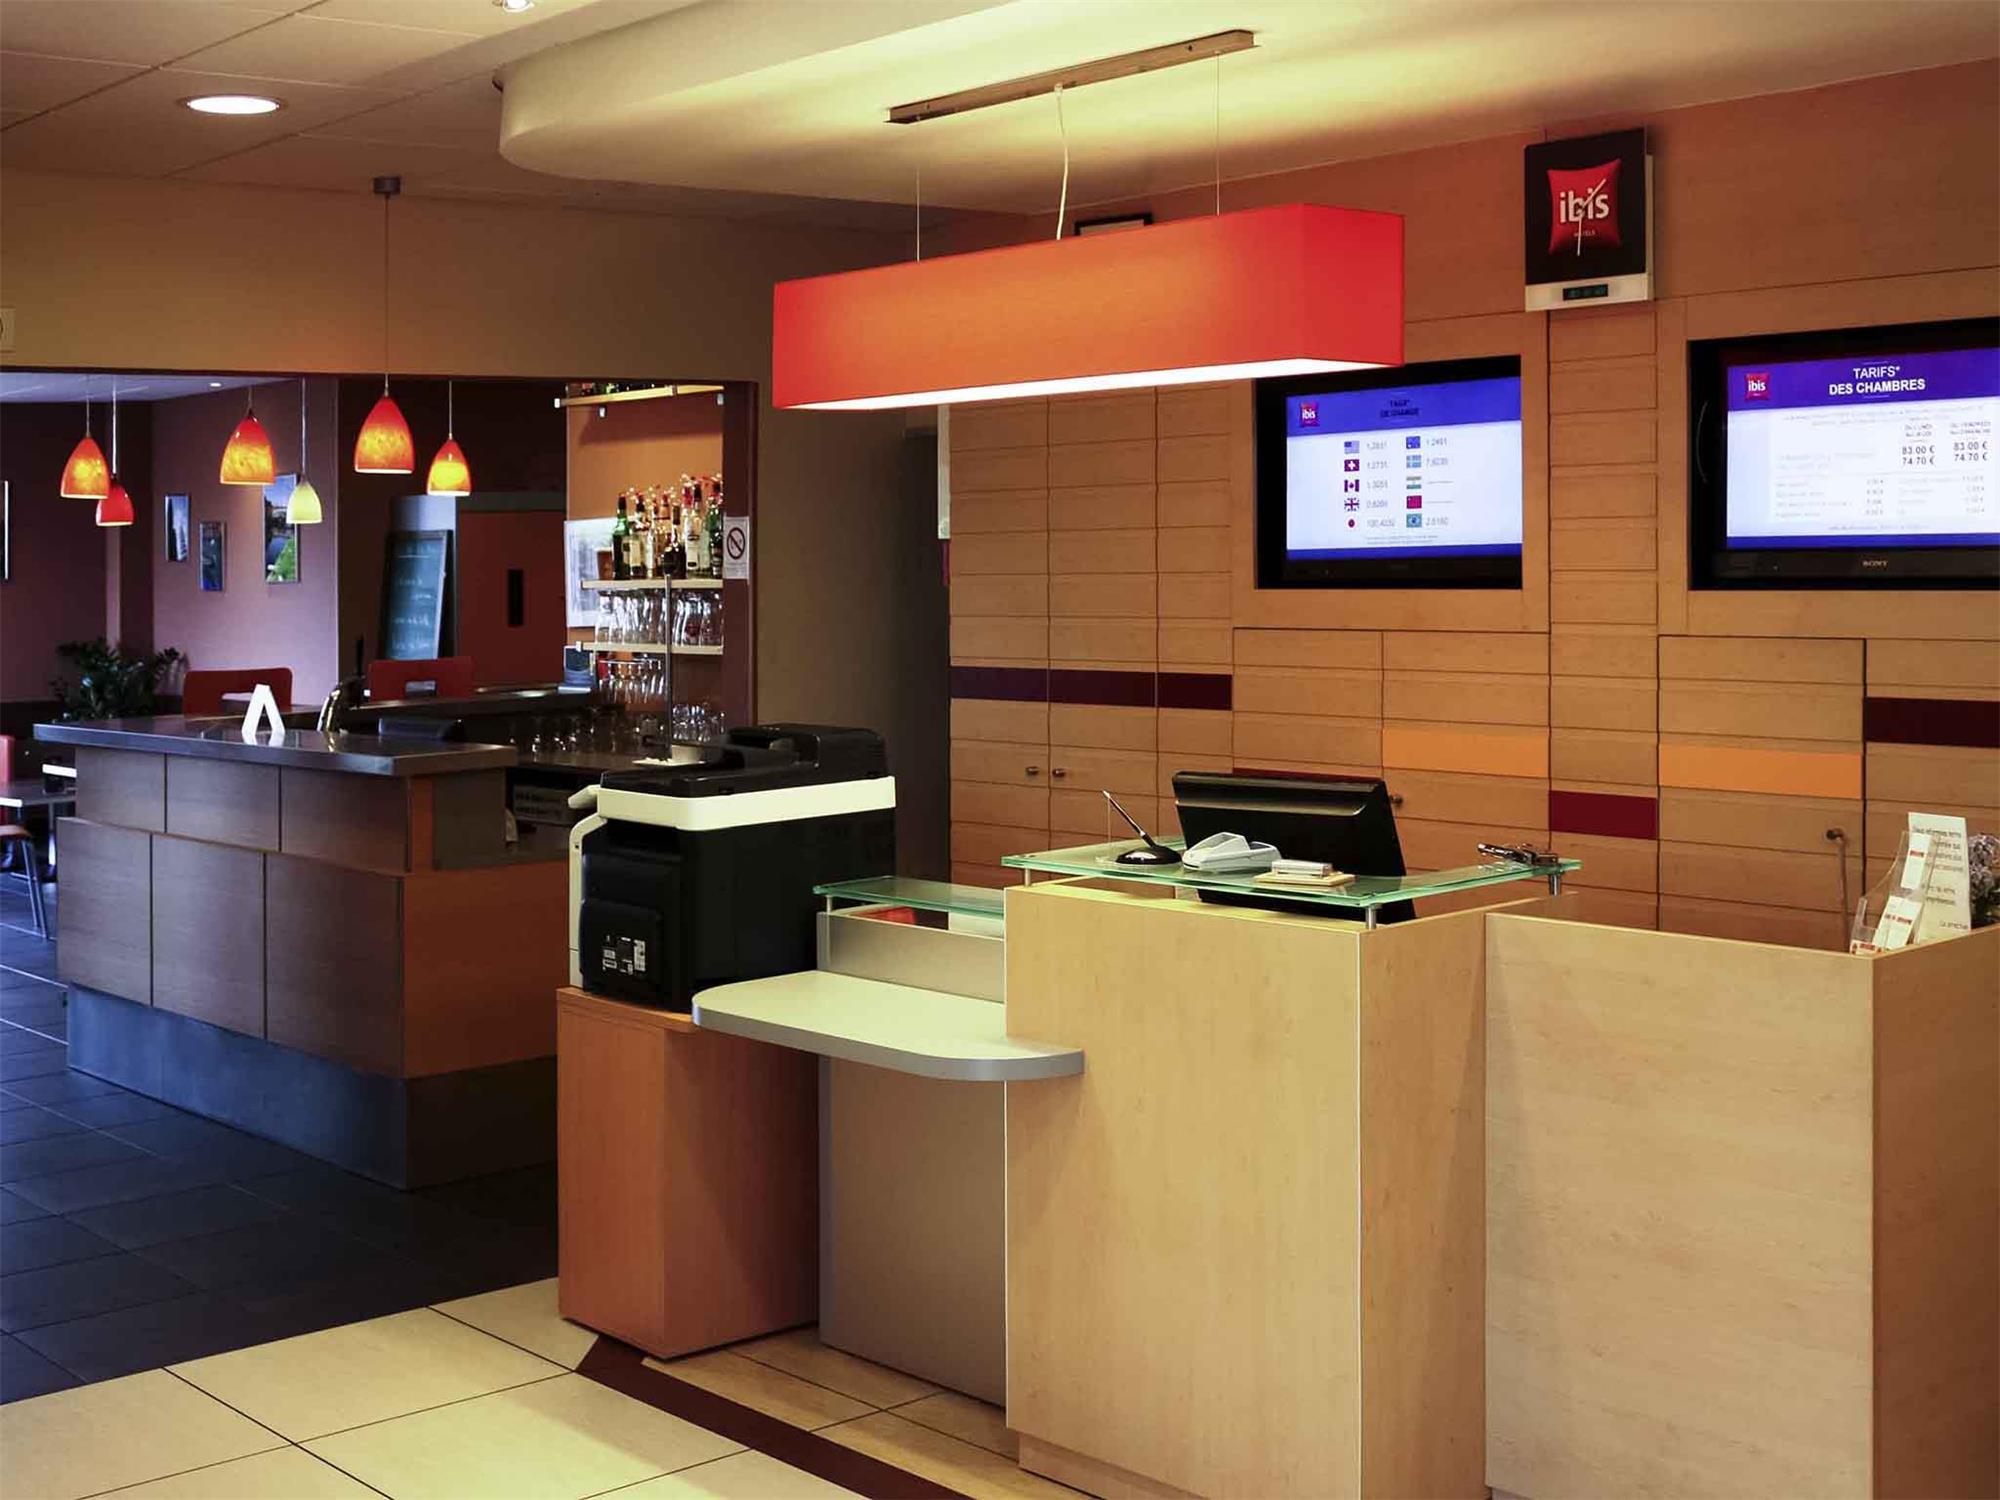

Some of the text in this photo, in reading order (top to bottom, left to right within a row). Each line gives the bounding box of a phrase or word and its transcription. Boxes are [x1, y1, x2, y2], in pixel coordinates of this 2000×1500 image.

[1560, 188, 1610, 223] ibis
[1748, 380, 1766, 392] ibis
[1829, 378, 1926, 395] DES CHAMBRES
[1302, 408, 1316, 420] ibis
